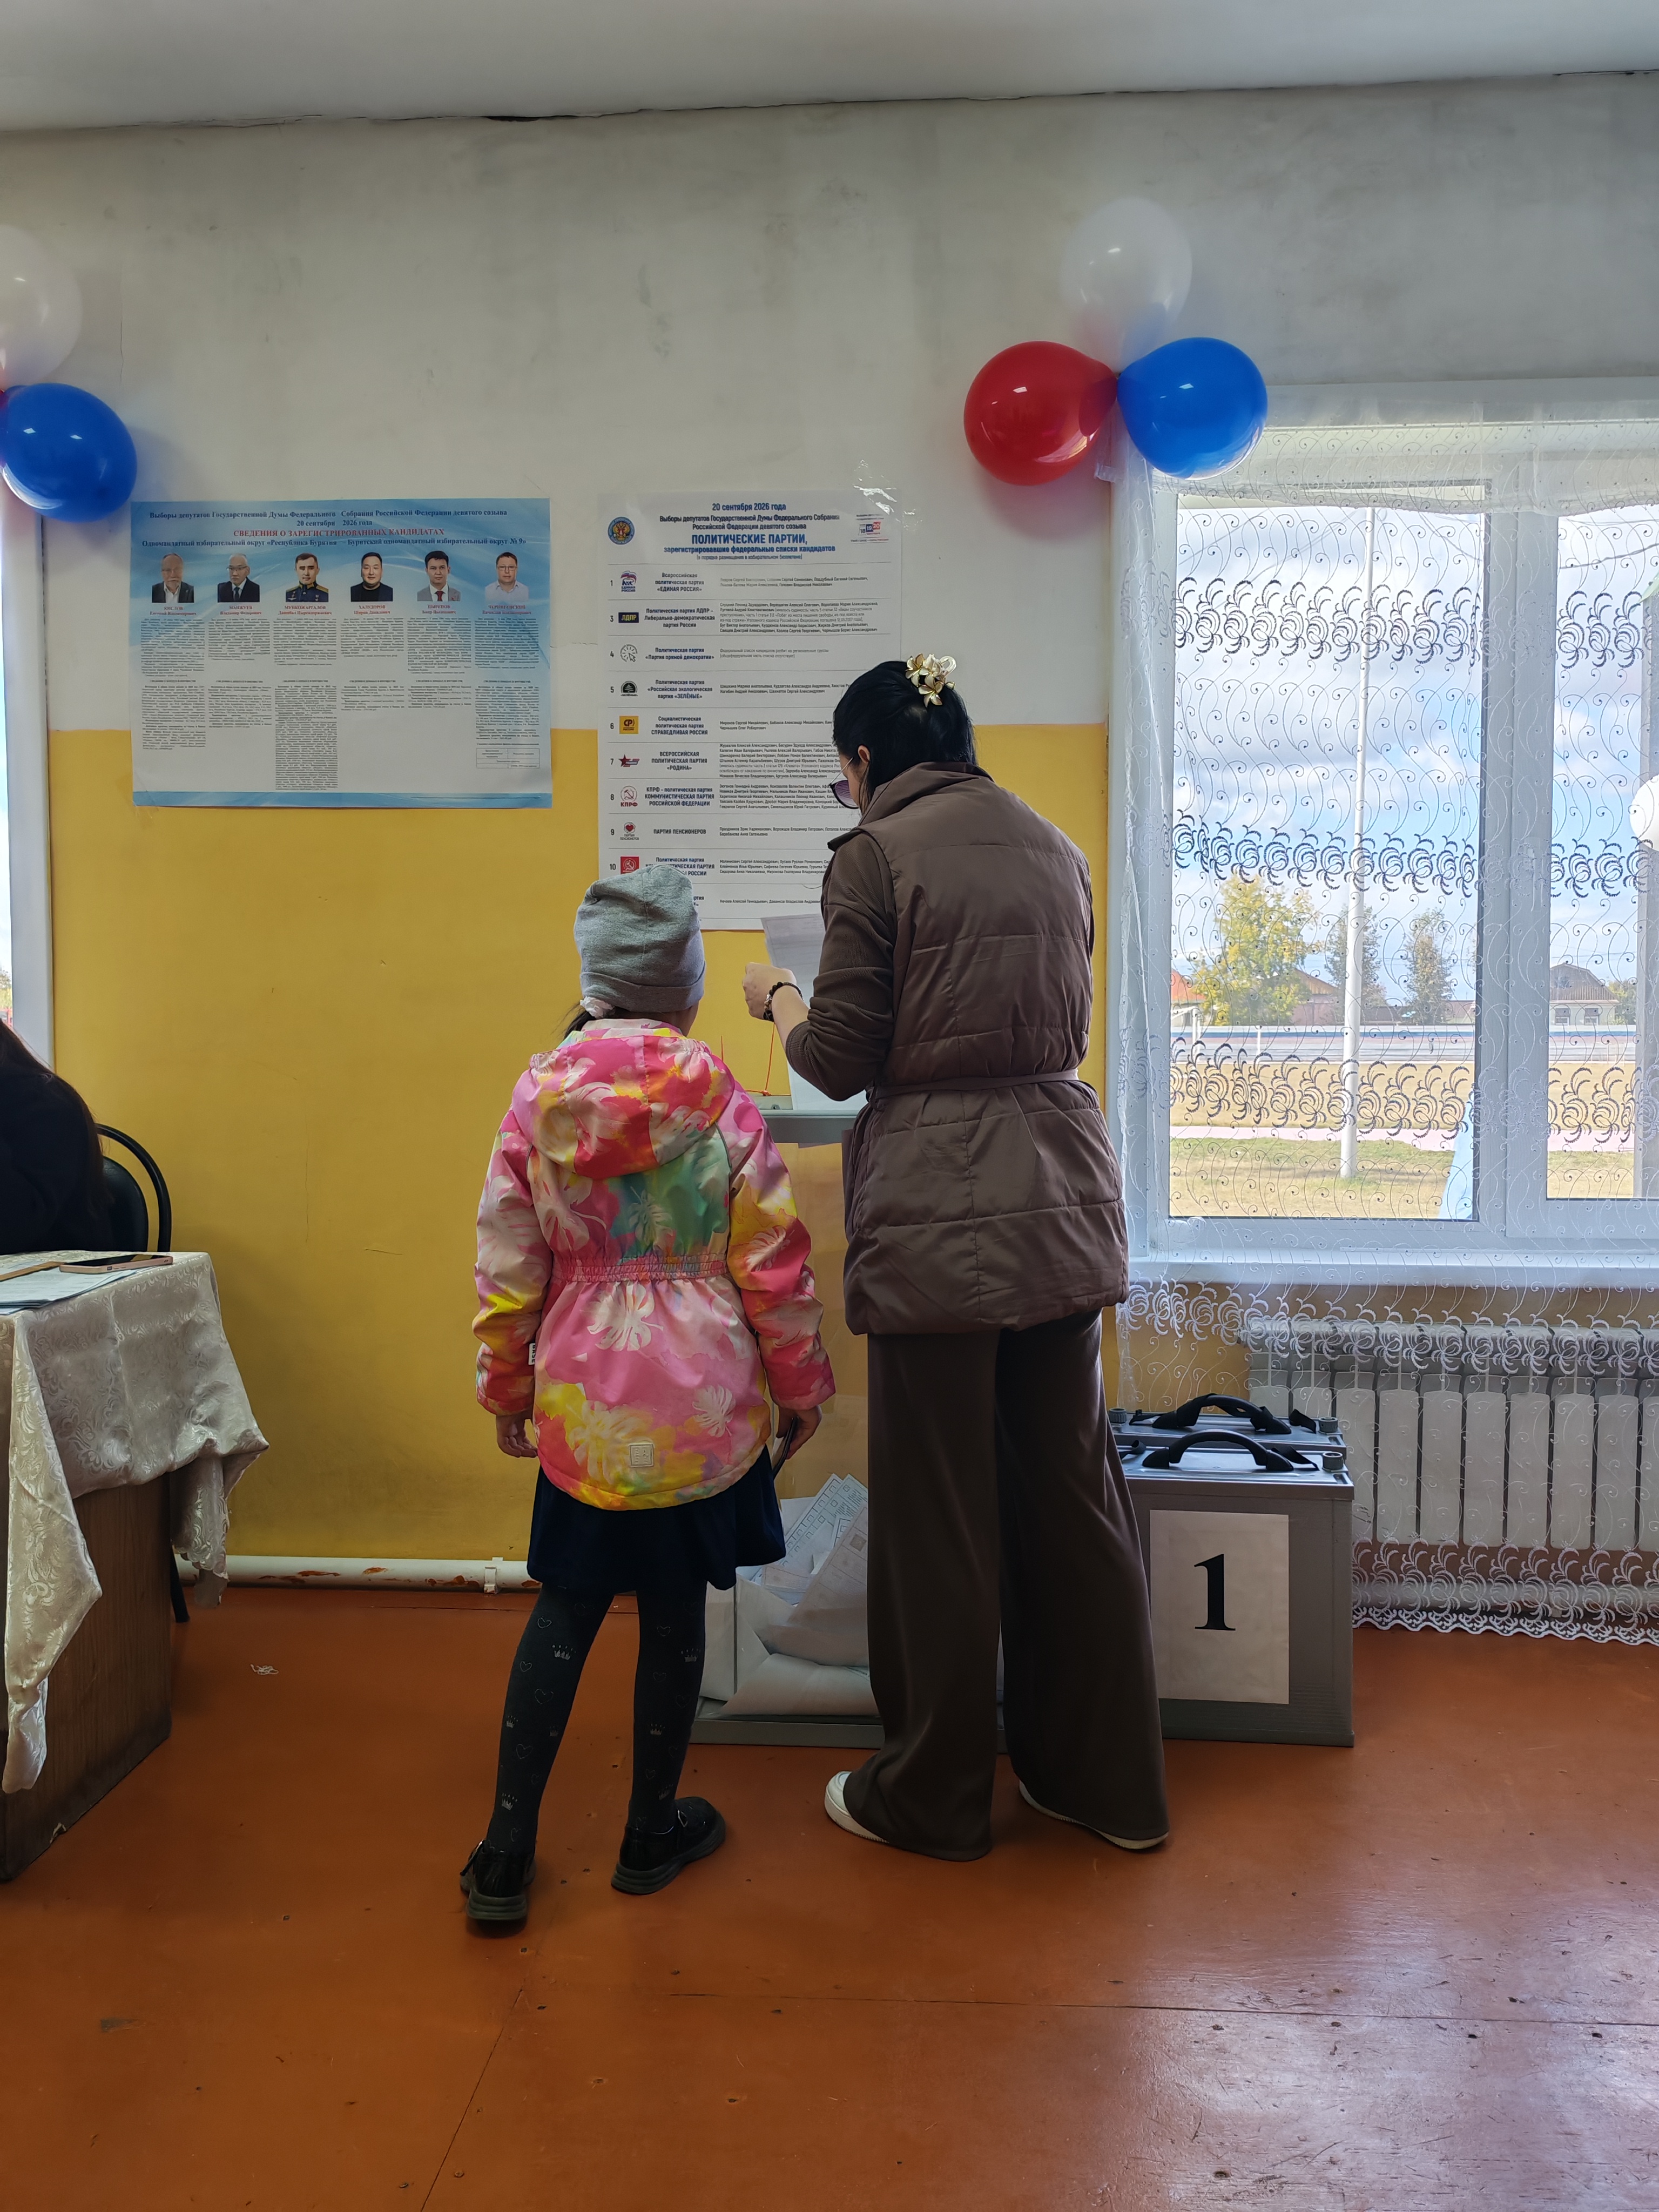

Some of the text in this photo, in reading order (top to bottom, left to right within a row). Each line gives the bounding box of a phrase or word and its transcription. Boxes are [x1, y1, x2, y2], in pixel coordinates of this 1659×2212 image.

[712, 503, 720, 511] 20
[721, 503, 752, 511] сентября
[754, 502, 770, 510] 2026
[691, 534, 807, 544] ПОЛИТИЧЕСКИЕ ПАРТИИ,
[1194, 1554, 1236, 1630] 1
